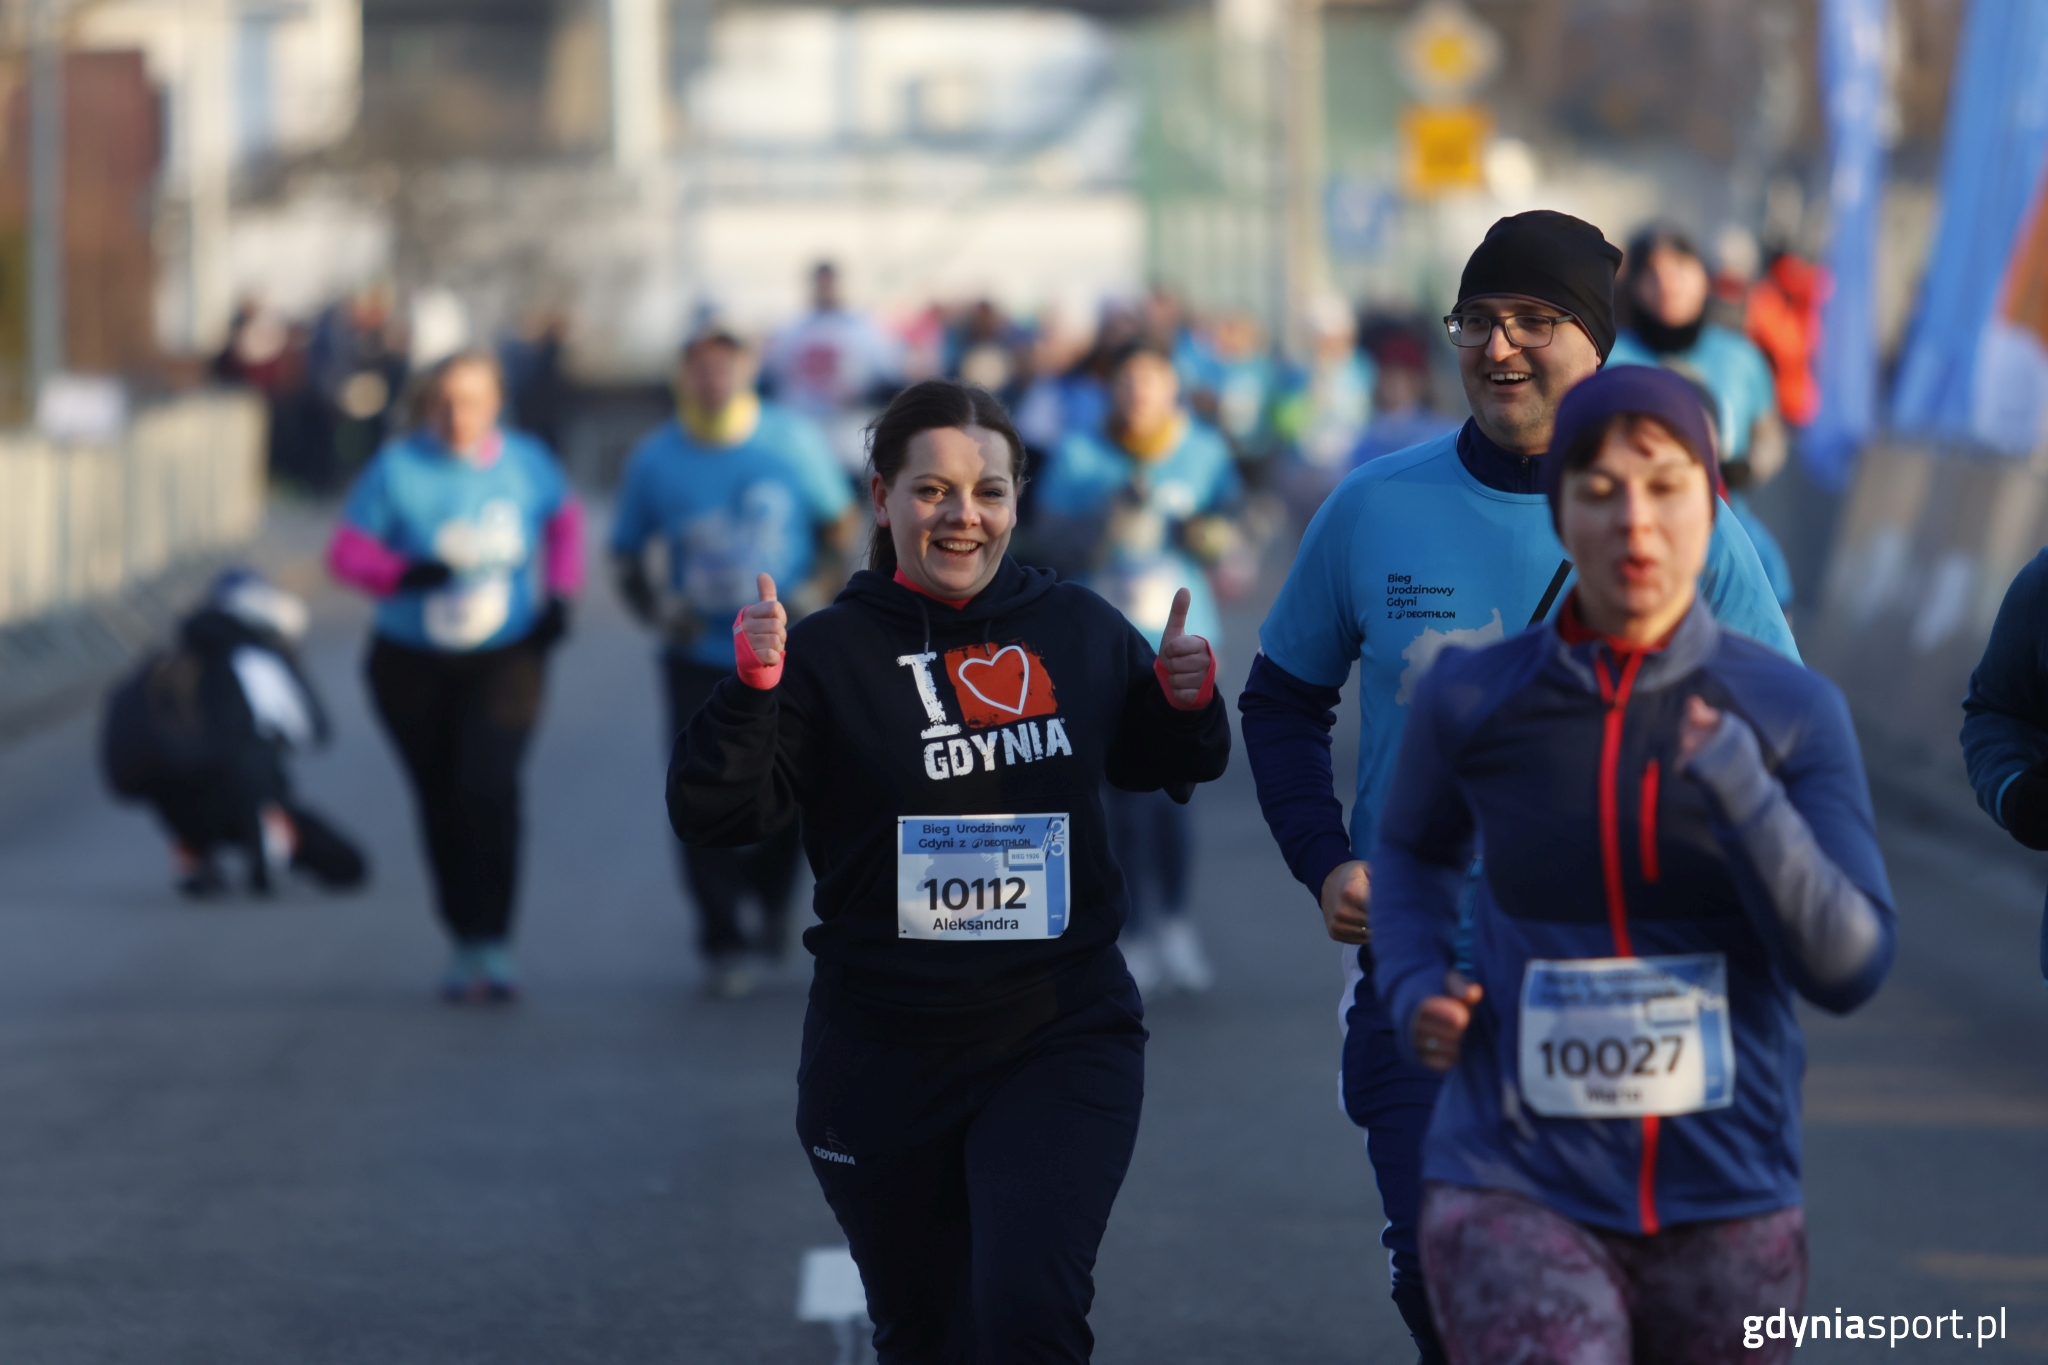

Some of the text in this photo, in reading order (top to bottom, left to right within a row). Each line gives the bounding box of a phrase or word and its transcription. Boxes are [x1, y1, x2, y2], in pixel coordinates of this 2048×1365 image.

[1387, 573, 1412, 585] Bieg
[1387, 585, 1455, 597] Urodzinowy
[1386, 597, 1417, 608] Gdyni
[1406, 611, 1456, 619] DECATHLON
[896, 652, 962, 740] I
[922, 823, 1026, 835] Bieg Urodzinowy
[918, 838, 1031, 850] Gdyni z DECATHLON
[923, 877, 1027, 911] 10112
[932, 917, 1019, 931] Aleksandra
[1539, 1035, 1685, 1078] 10027
[813, 1145, 856, 1165] GDYNIA
